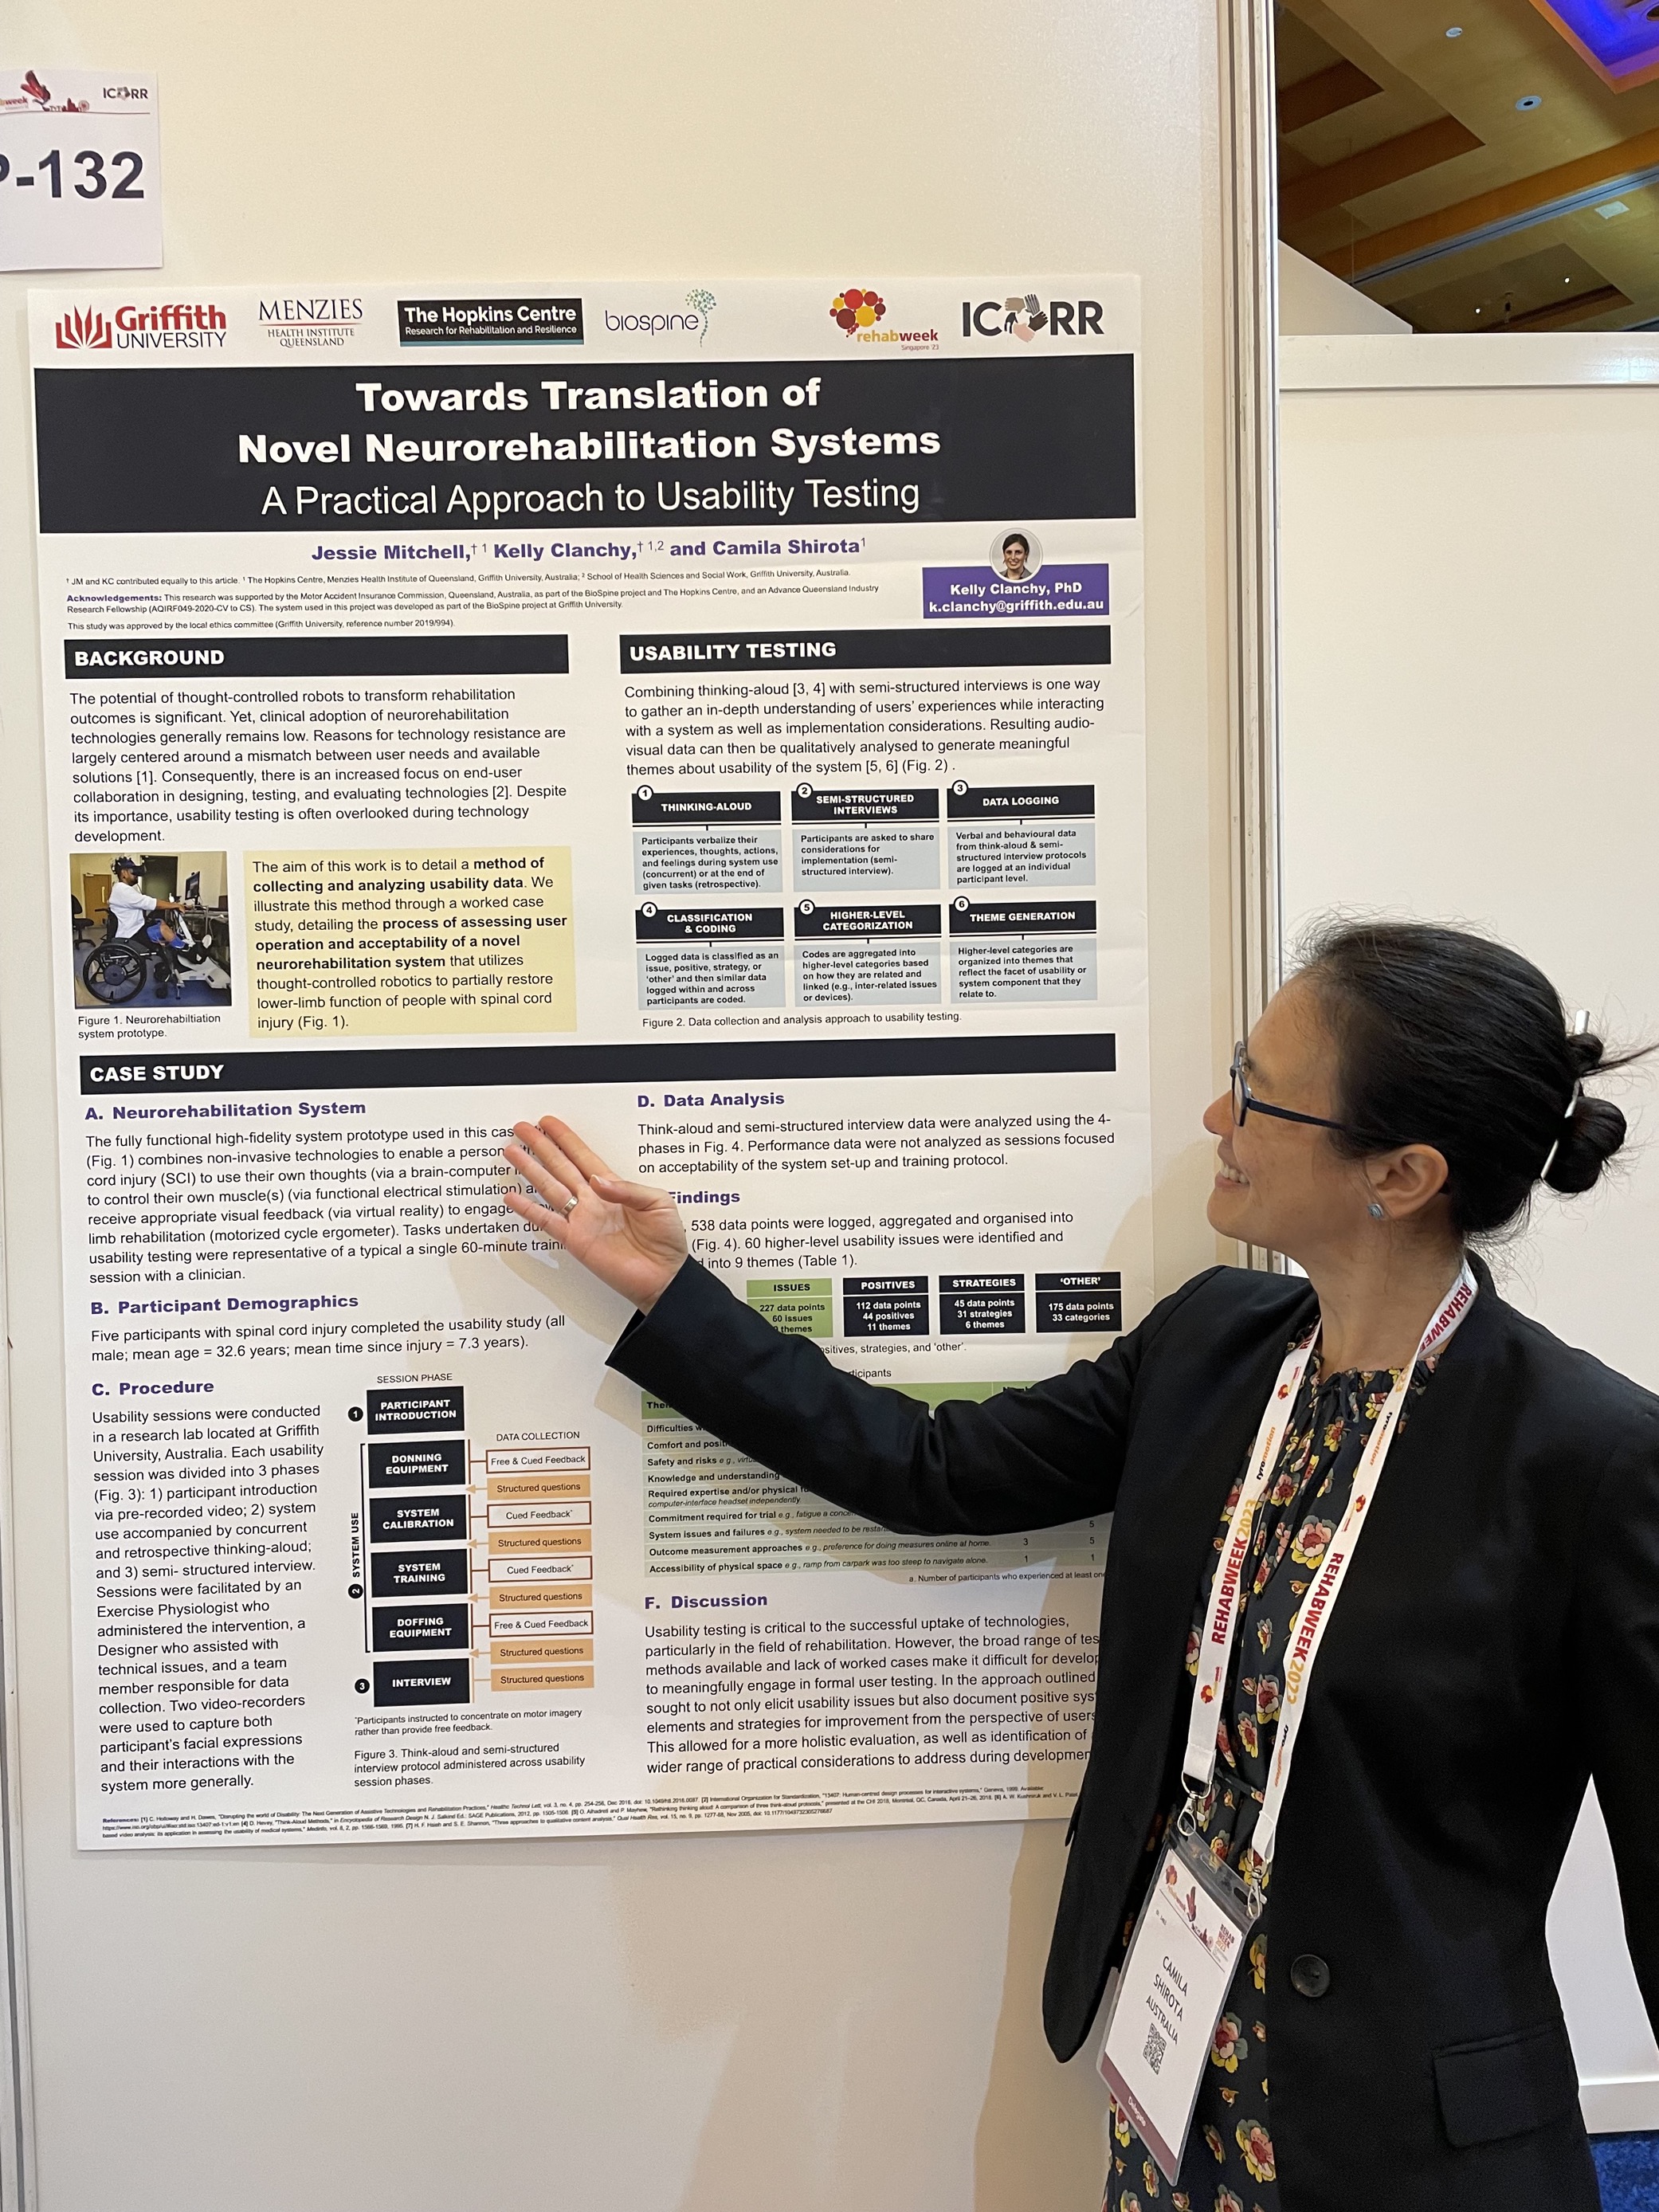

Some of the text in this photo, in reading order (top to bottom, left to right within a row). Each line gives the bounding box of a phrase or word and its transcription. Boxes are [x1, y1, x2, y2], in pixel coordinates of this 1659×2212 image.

[0, 148, 145, 200] -132
[260, 299, 362, 320] MENZIES
[404, 306, 576, 325] The Hopkins Centre
[116, 305, 226, 331] Griffith
[606, 311, 698, 335] biospine
[117, 332, 226, 348] UNIVERSITY
[280, 338, 343, 347] QUEENSLAND
[857, 328, 939, 343] rehabweek
[356, 378, 821, 411] Towards Translation of
[239, 428, 940, 463] Novel Neurorehabilitation Systems
[262, 478, 918, 520] A Practical Approach to Usability Testing
[312, 546, 376, 559] Jessie
[494, 543, 544, 560] Kelly
[671, 542, 705, 555] and
[713, 540, 781, 555] Camila
[951, 579, 1081, 597] Kelly Clanchy, PhD
[930, 599, 1103, 614] k.clanchy@griffith.edu.au
[75, 650, 224, 665] BACKGROUND
[630, 642, 836, 661] USABILITY TESTING
[70, 688, 515, 707] The potential of thought-controlled robots to transform rehabilitation
[817, 794, 914, 803] SEMI-STRUCTURED
[661, 802, 751, 811] THINKING-ALOUD
[831, 911, 905, 920] HIGHER-LEVEL
[1009, 912, 1075, 920] GENERATION
[823, 921, 912, 930] CATEGORIZATION
[79, 1017, 109, 1027] Figure
[79, 1030, 167, 1041] system prototype.
[91, 1065, 224, 1081] CASE STUDY
[638, 1092, 784, 1108] D. Data Analysis
[85, 1103, 365, 1120] A. Neurorehabilitation System
[92, 1296, 358, 1315] B. Participant Demographics
[92, 1381, 214, 1395] C. Procedure
[381, 1400, 450, 1410] PARTICIPANT
[375, 1410, 456, 1421] INTRODUCTION
[496, 1431, 580, 1441] DATA COLLECTION
[392, 1453, 441, 1463] DONNING
[1256, 1426, 1277, 1481] tyromotion
[386, 1465, 448, 1474] EQUIPMENT
[383, 1520, 453, 1529] CALIBRATION
[351, 1512, 361, 1578] SYSTEM USE
[650, 1564, 704, 1573] Accessibility
[719, 1563, 754, 1571] physical
[394, 1574, 445, 1583] TRAINING
[645, 1594, 767, 1609] F. Discussion
[398, 1618, 443, 1626] DOFFING
[646, 1615, 1069, 1638] Usability testing is critical to the successful uptake of technologies,
[390, 1628, 452, 1637] EQUIPMENT
[393, 1677, 450, 1687] INTERVIEW
[1162, 1955, 1188, 1997] CAMILA
[1153, 1974, 1184, 2022] SHIROTA
[1145, 1995, 1179, 2045] AUSTRALIA
[1127, 2096, 1147, 2128] Delegate
